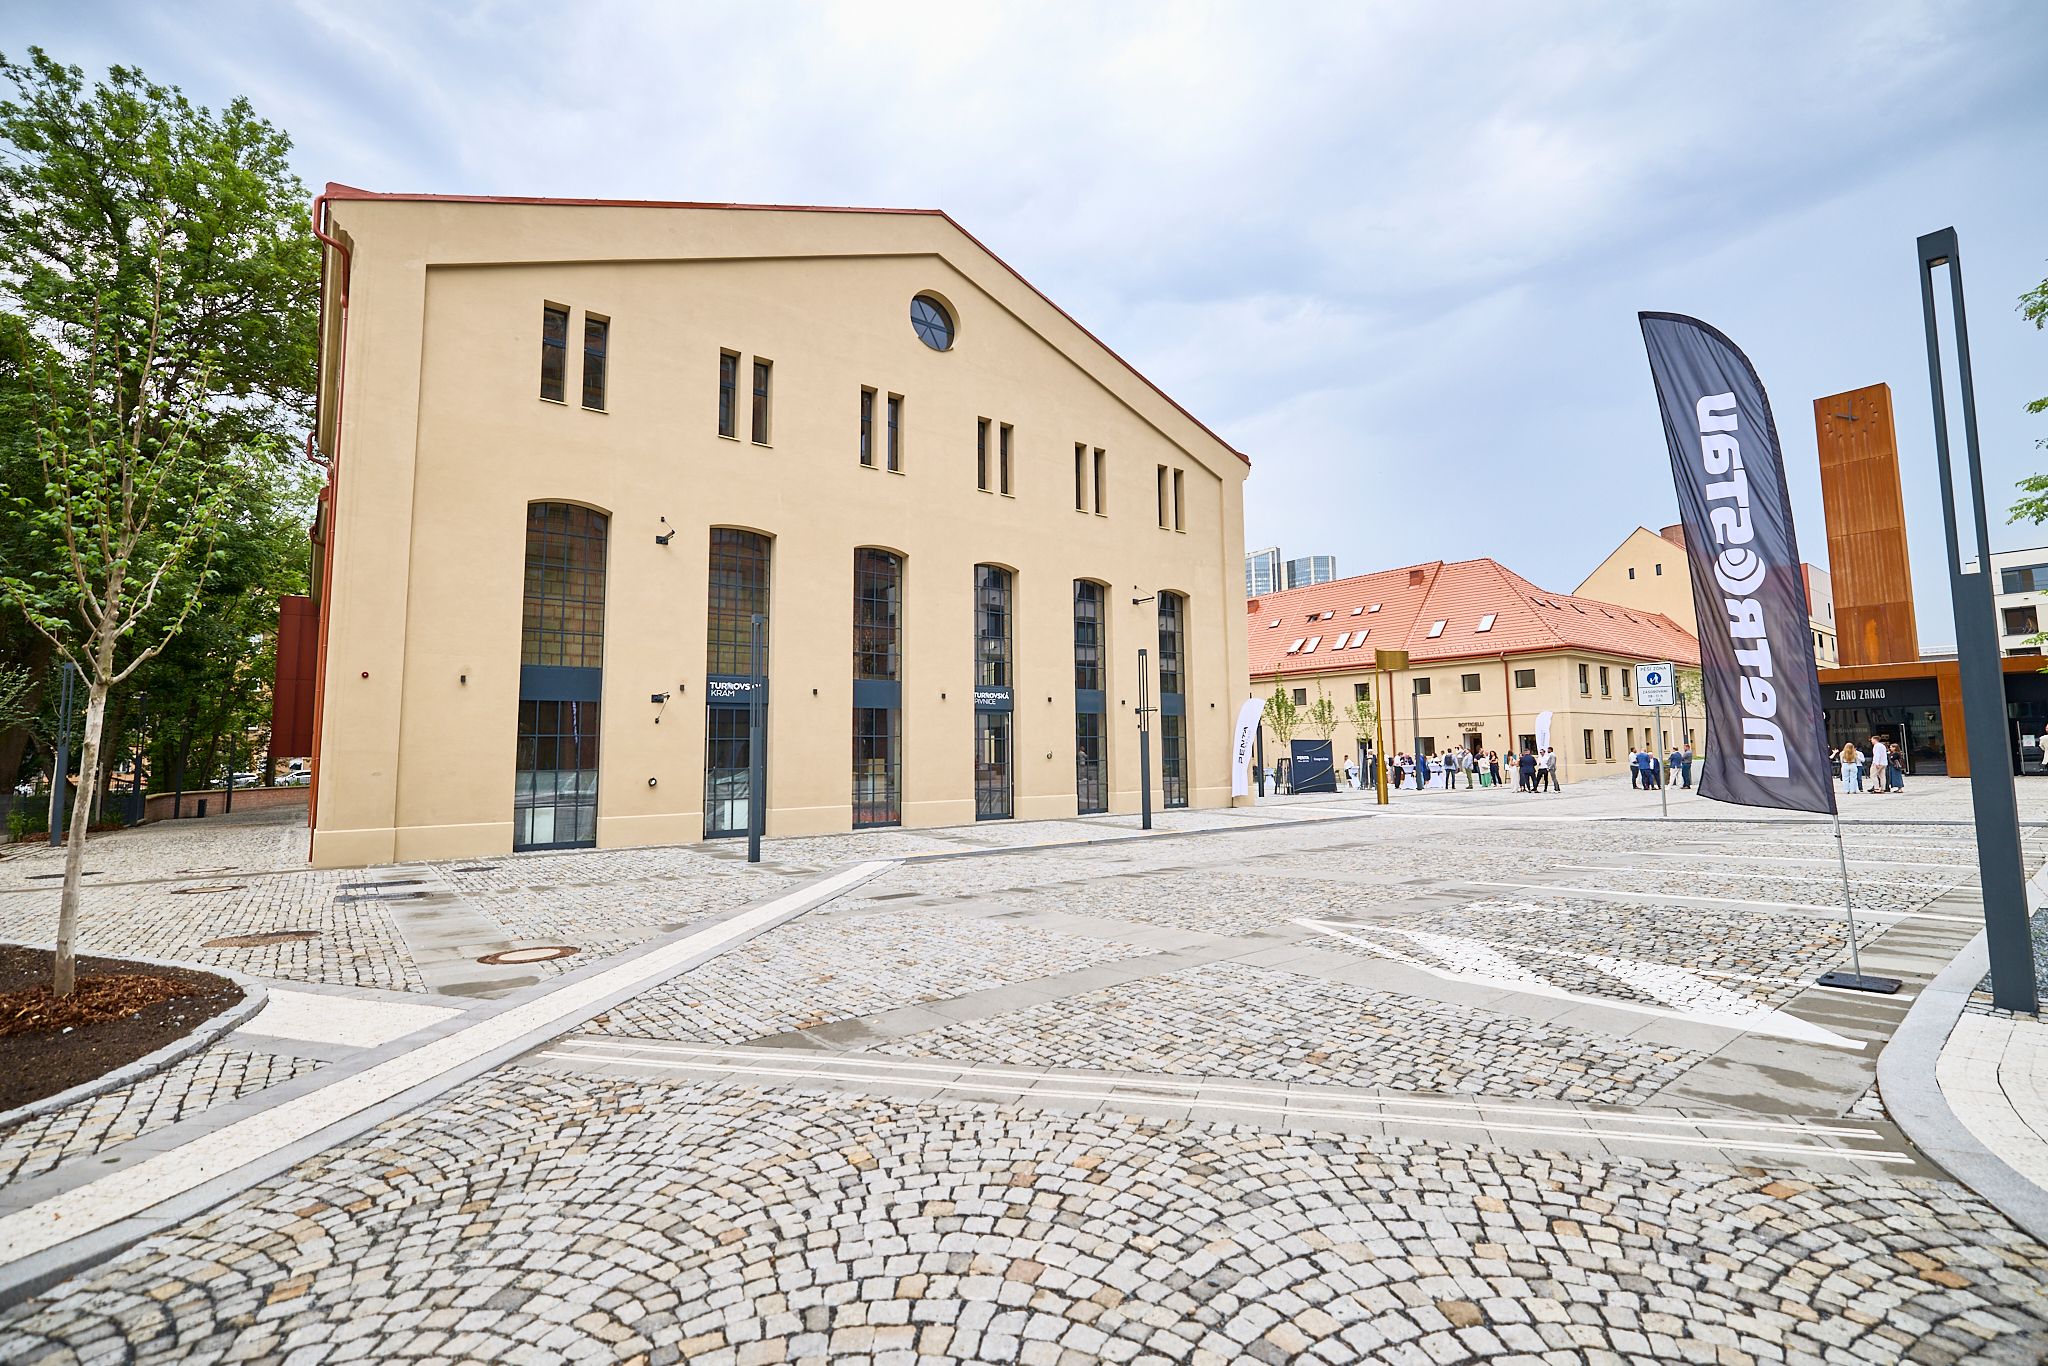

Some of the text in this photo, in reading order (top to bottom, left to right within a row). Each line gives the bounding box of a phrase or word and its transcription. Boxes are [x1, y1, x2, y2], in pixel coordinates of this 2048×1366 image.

[1835, 688, 1886, 701] ZRNO ZRNKO
[1238, 726, 1249, 764] PENTA
